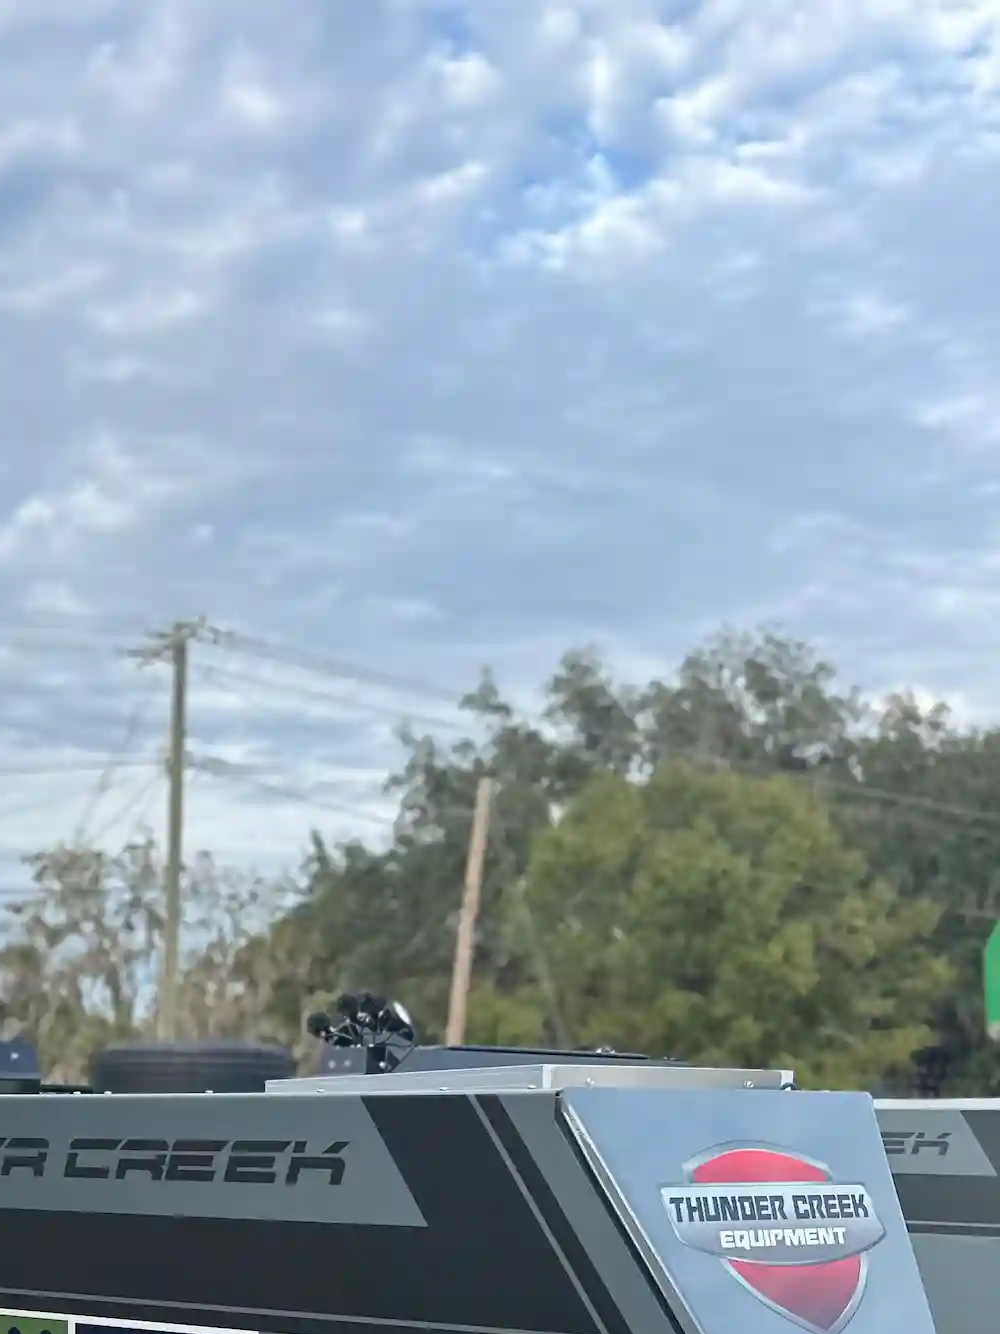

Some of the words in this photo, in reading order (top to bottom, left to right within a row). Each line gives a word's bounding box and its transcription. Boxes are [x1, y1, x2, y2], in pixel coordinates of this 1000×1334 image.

[64, 1138, 352, 1186] CREEK
[668, 1194, 788, 1223] THUNDER
[792, 1193, 870, 1220] CREEK
[719, 1227, 847, 1250] EQUIPMENT
